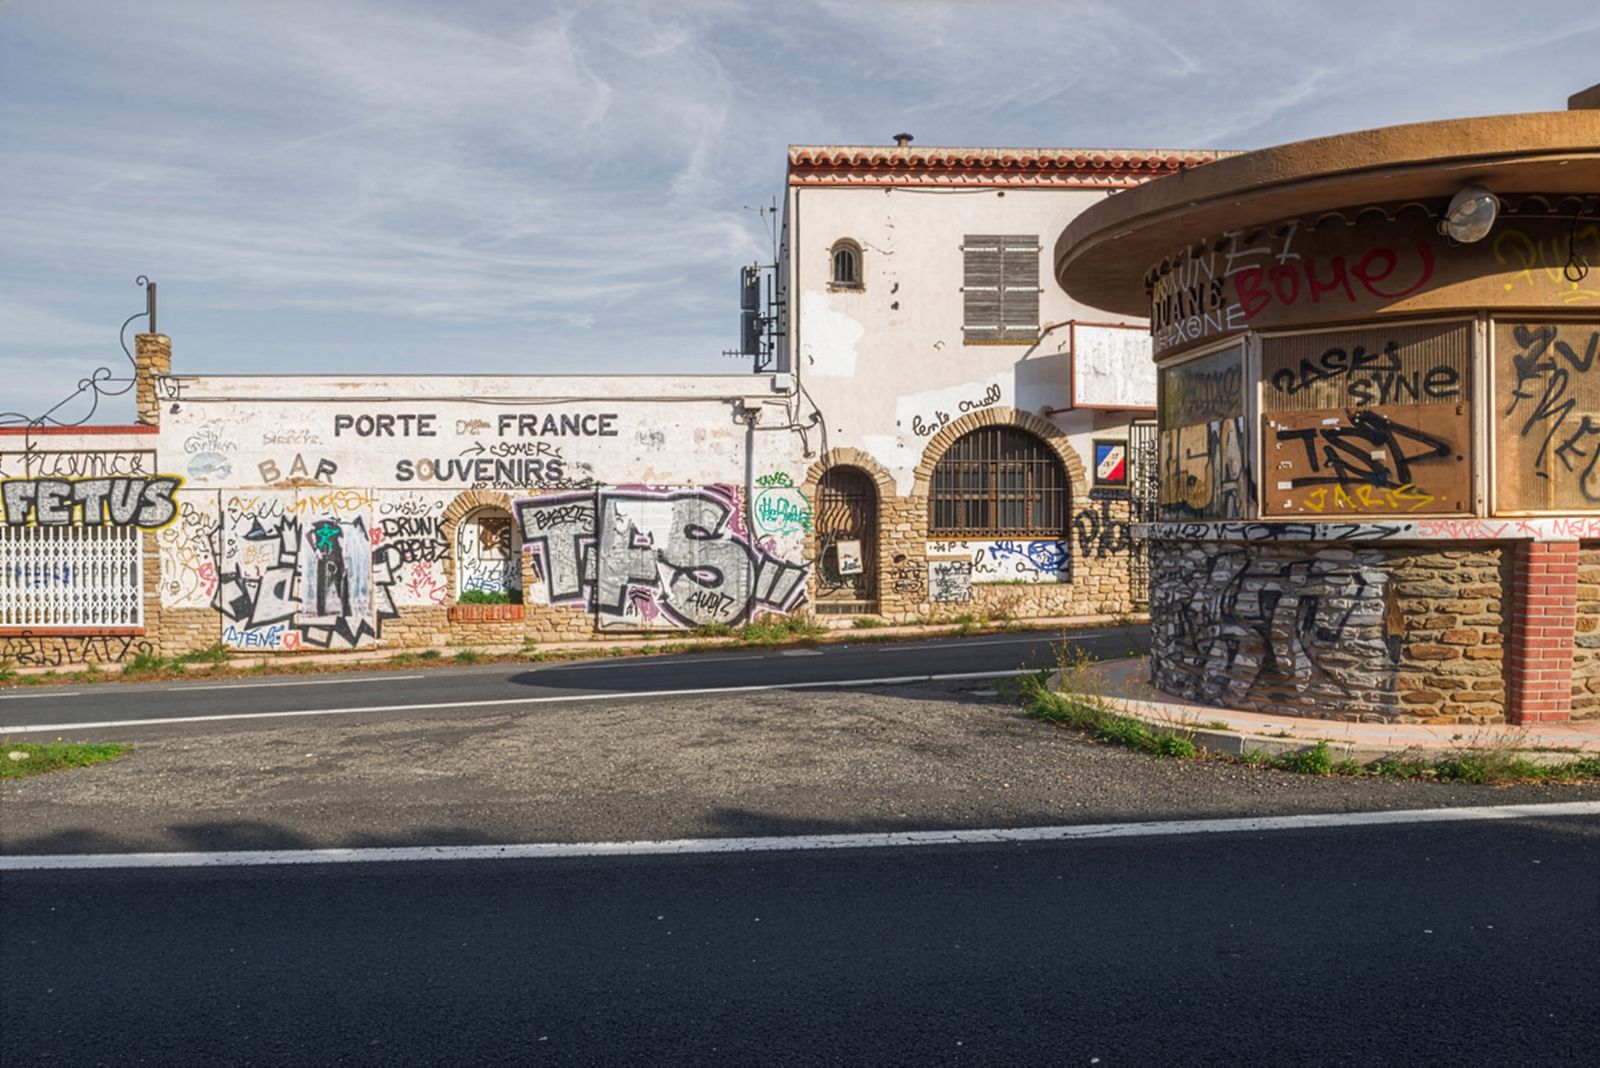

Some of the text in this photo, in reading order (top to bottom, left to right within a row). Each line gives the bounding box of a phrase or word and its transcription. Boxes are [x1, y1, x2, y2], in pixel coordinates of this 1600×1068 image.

[334, 414, 437, 437] PORTE
[497, 413, 619, 437] FRANCE
[257, 453, 338, 484] BAR
[395, 457, 565, 483] SOUVENIRS
[0, 475, 183, 531] FETUS
[379, 516, 450, 541] DRUNK
